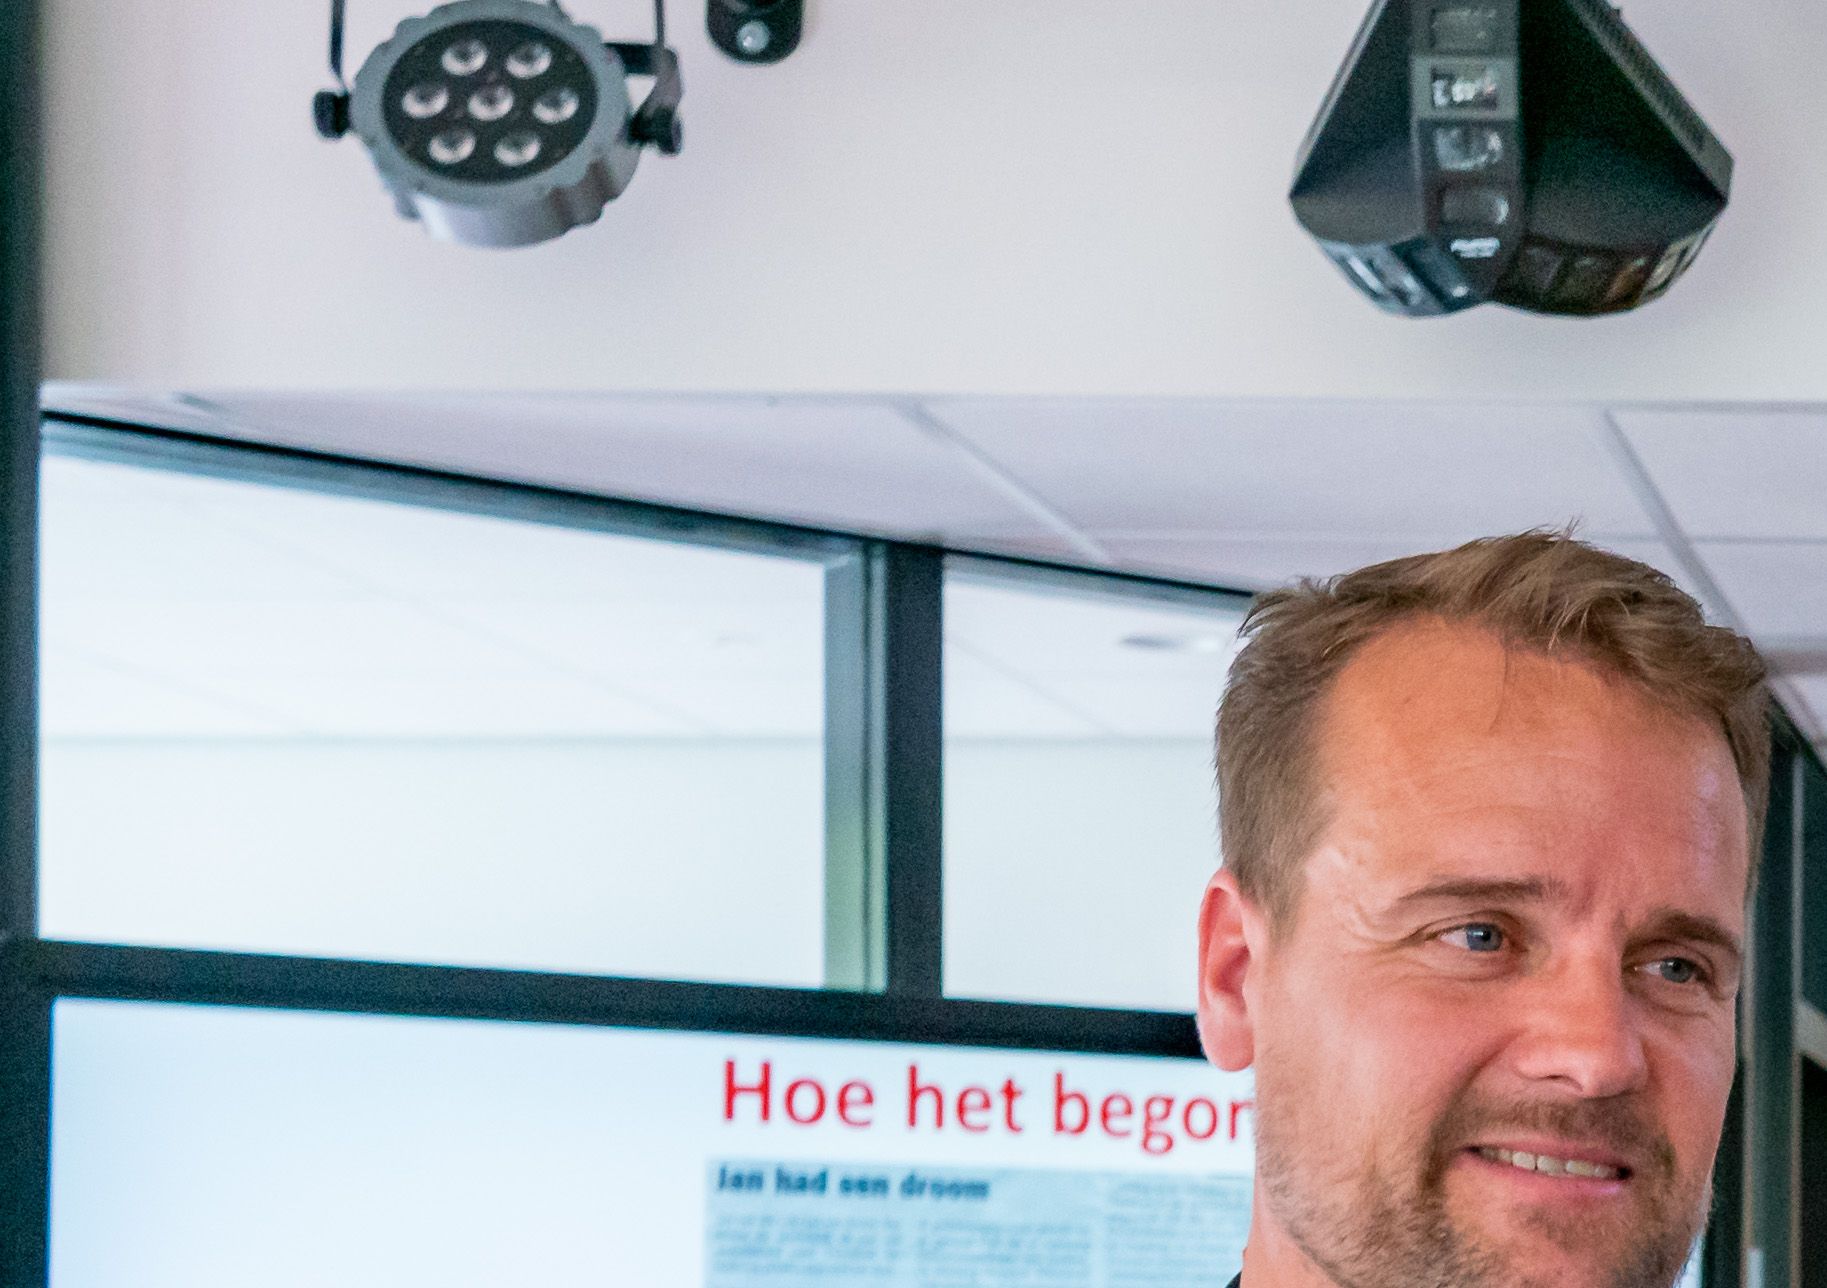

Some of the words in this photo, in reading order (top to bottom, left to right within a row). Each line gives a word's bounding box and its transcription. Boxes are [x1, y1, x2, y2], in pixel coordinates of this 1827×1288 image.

[724, 1060, 875, 1127] Hoe
[908, 1064, 1023, 1133] het
[718, 1164, 764, 1192] Jan
[774, 1166, 829, 1196] had
[839, 1173, 889, 1196] een
[899, 1168, 990, 1200] droom
